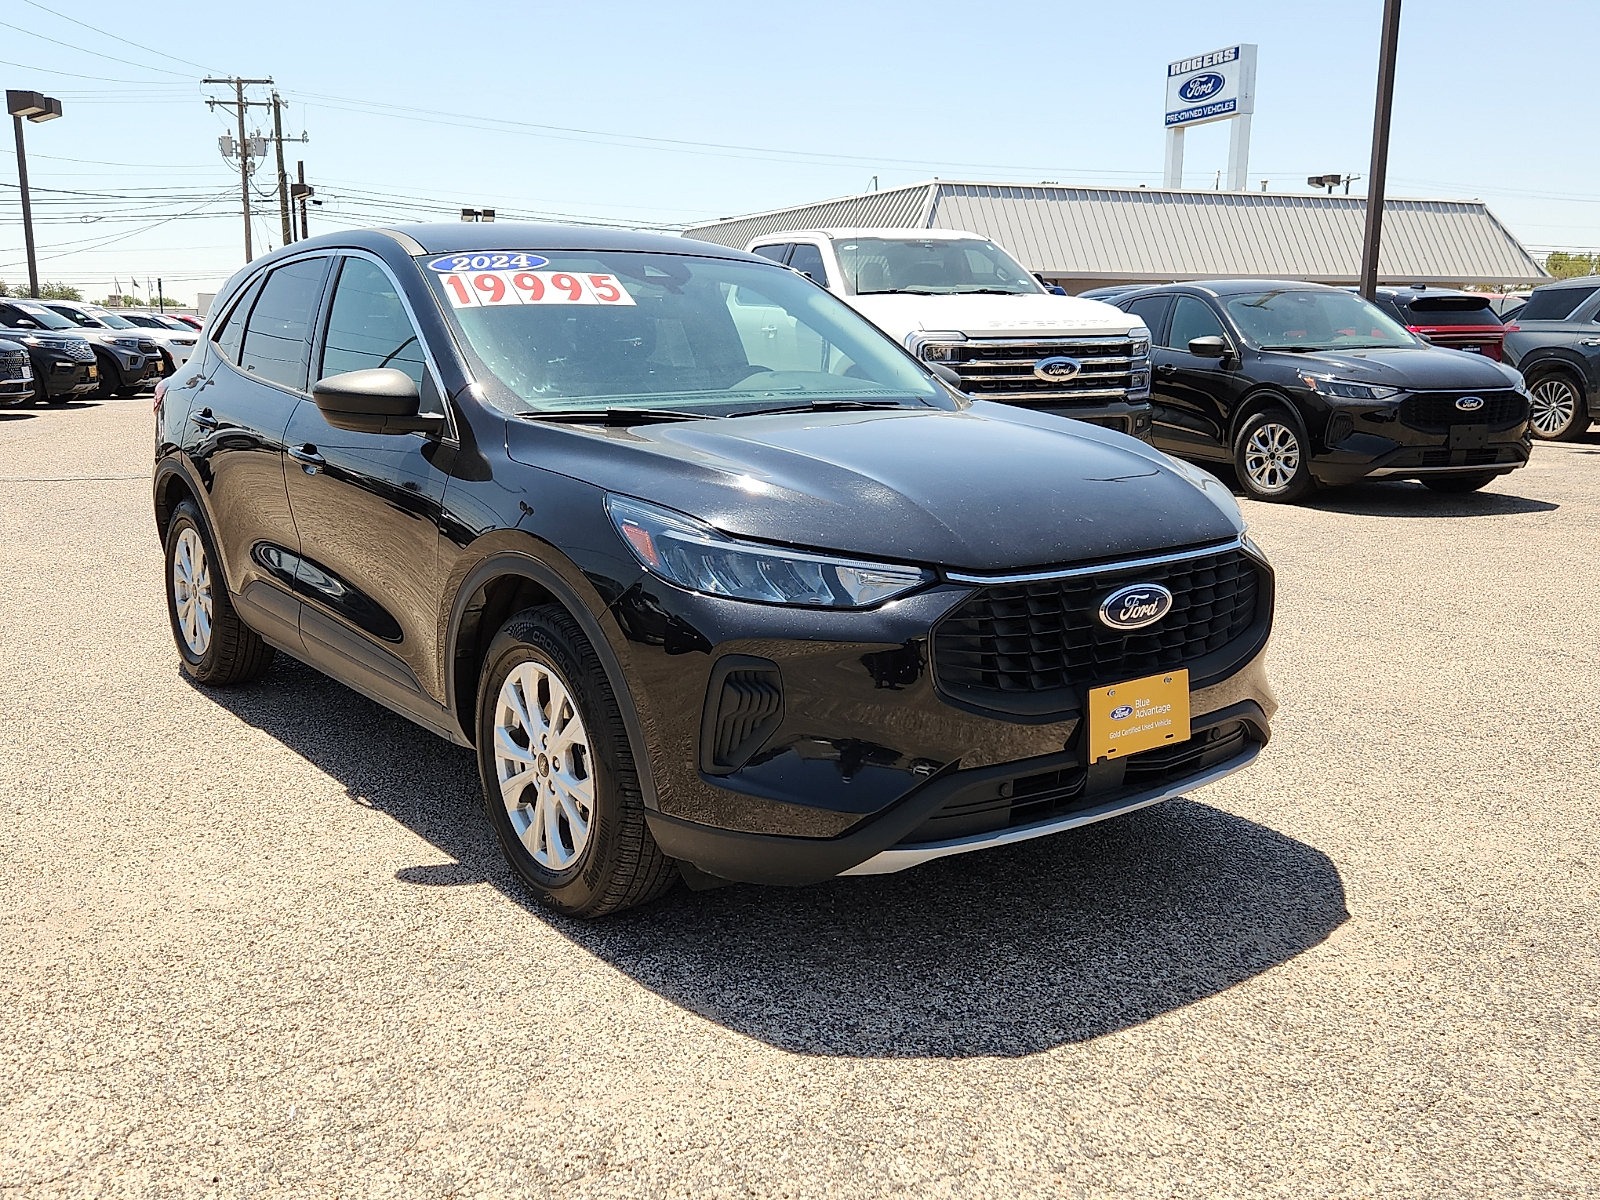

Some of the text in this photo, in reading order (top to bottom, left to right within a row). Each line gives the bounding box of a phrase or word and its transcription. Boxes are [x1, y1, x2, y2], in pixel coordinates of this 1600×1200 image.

[1170, 48, 1236, 76] ROGERS
[1186, 76, 1216, 98] Ford
[1166, 101, 1235, 124] PRE-OWNED VEHICLES
[451, 254, 532, 272] 2024
[446, 273, 621, 305] 19995
[1048, 363, 1072, 375] Ford
[1462, 399, 1479, 408] Ford
[1119, 593, 1160, 621] Ford
[1113, 706, 1131, 719] Ford
[1135, 698, 1151, 709] Blue
[1135, 703, 1171, 719] Advantage
[1109, 718, 1172, 740] Gold Certified Used Vehicle
